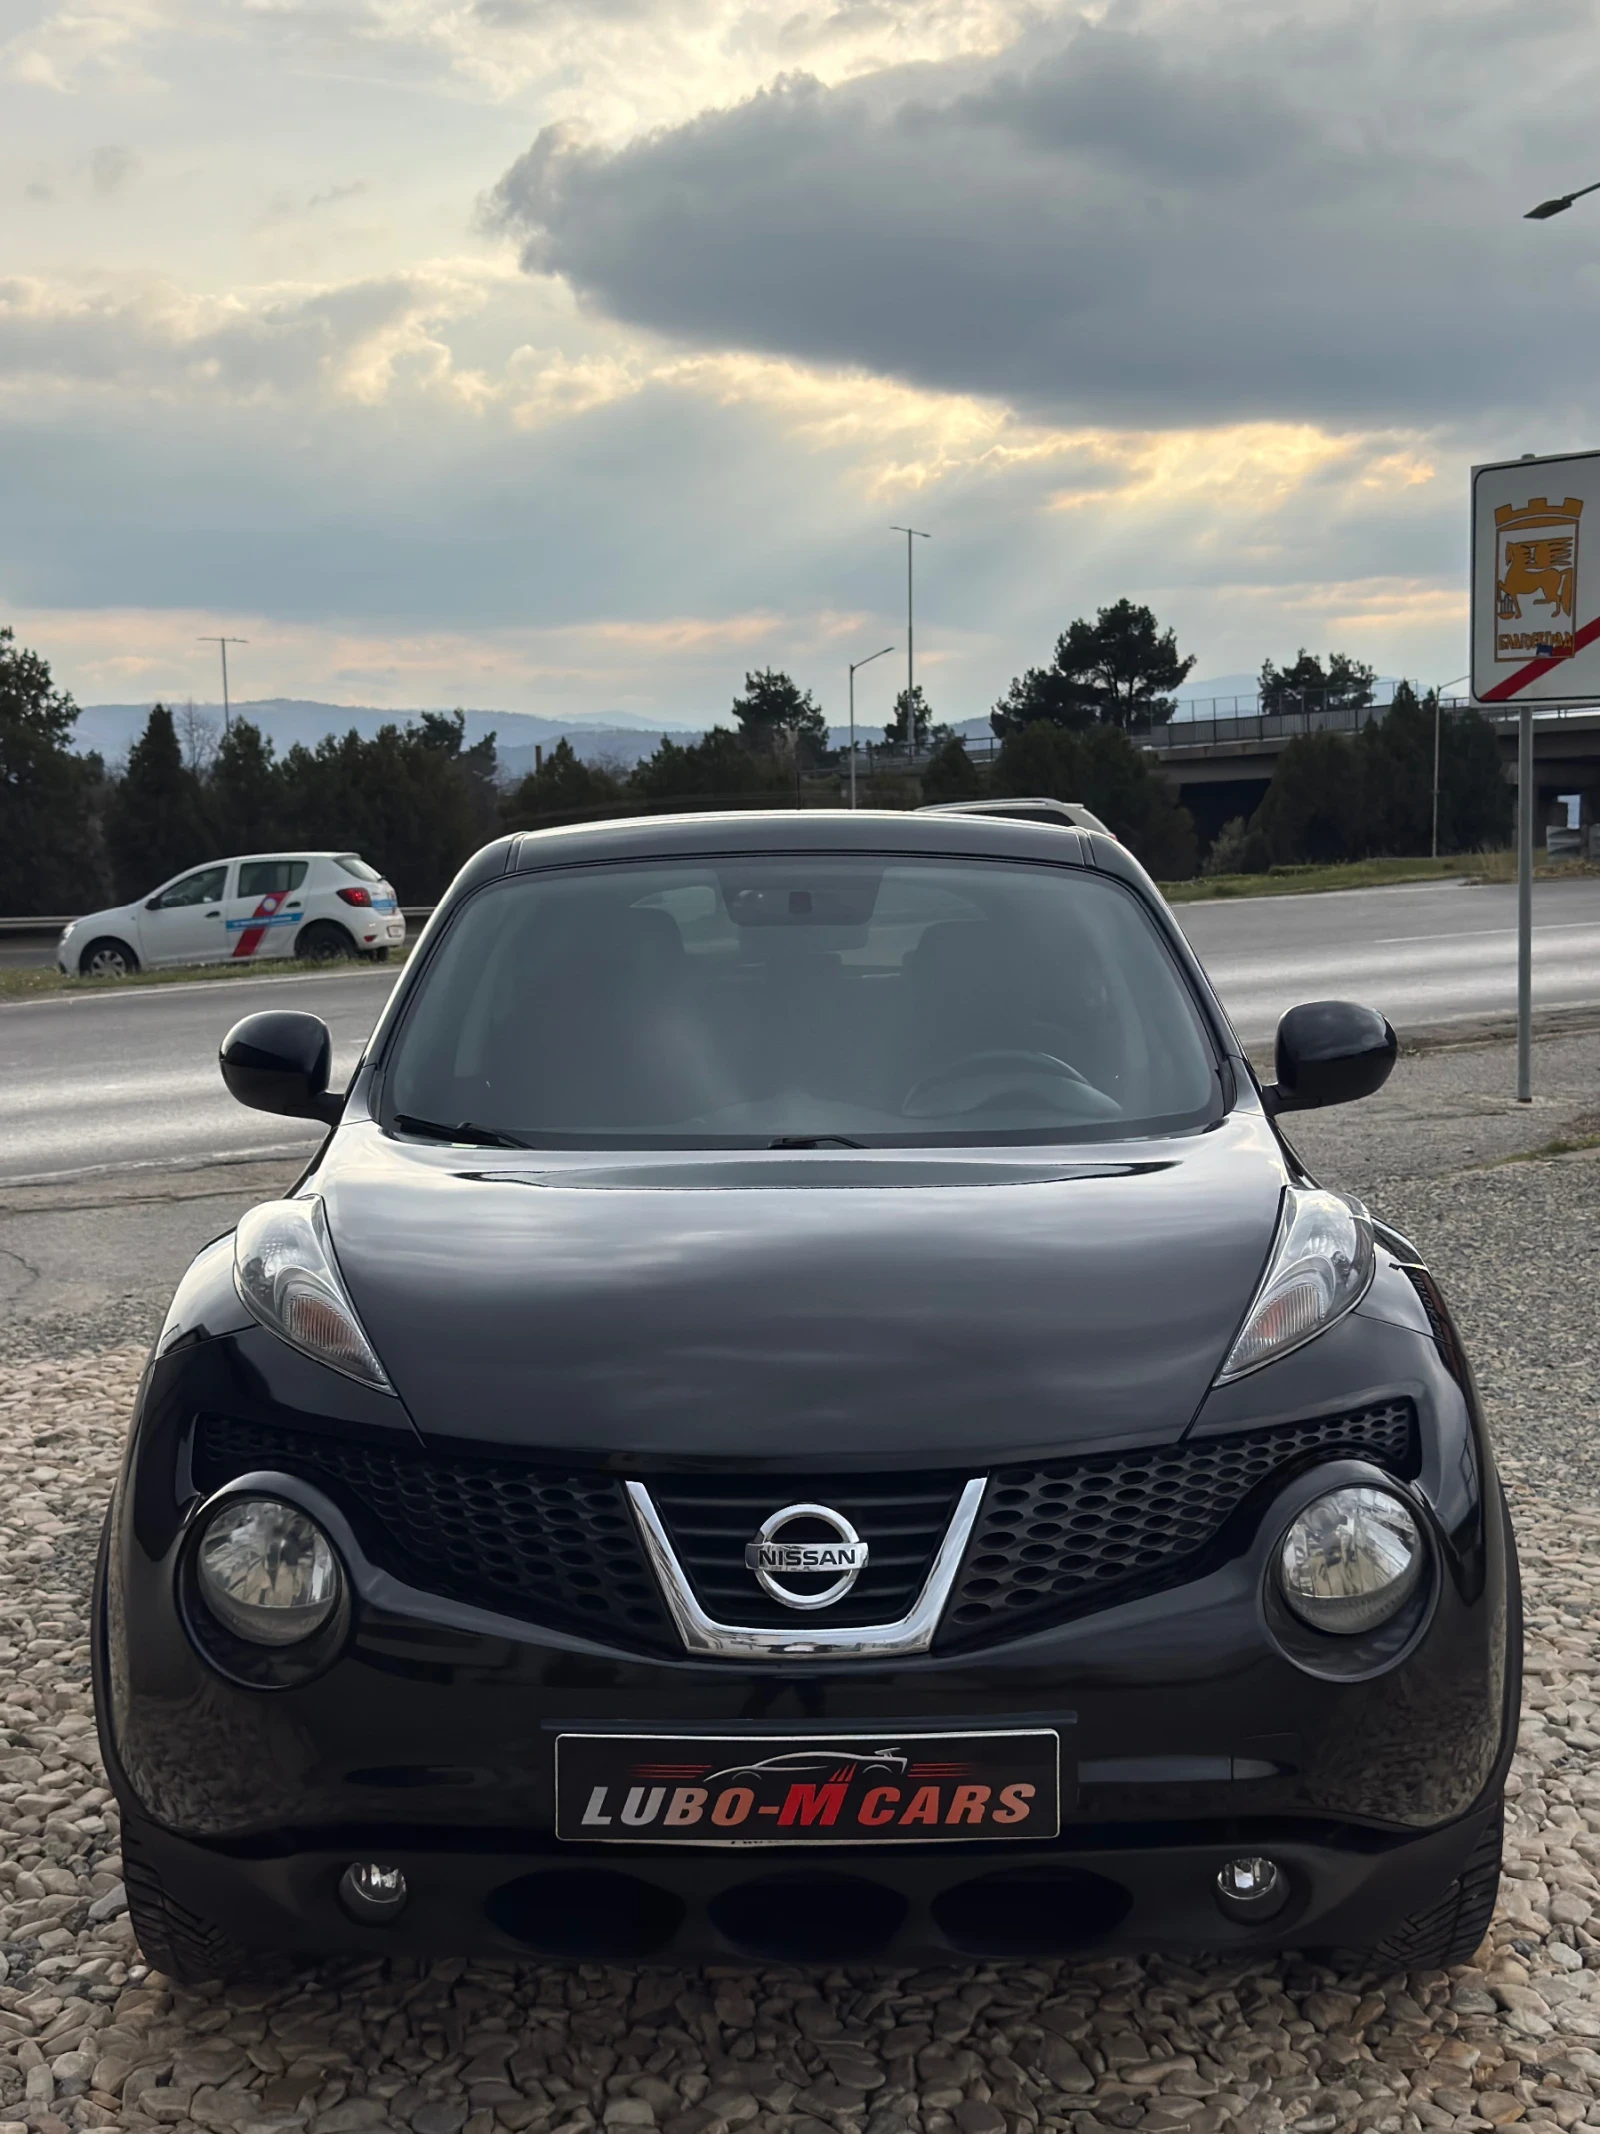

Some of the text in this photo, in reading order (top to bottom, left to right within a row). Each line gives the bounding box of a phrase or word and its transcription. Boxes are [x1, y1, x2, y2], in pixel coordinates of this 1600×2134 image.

[759, 1549, 856, 1566] NISSAN
[581, 1783, 1036, 1826] LUBO-M CARS
